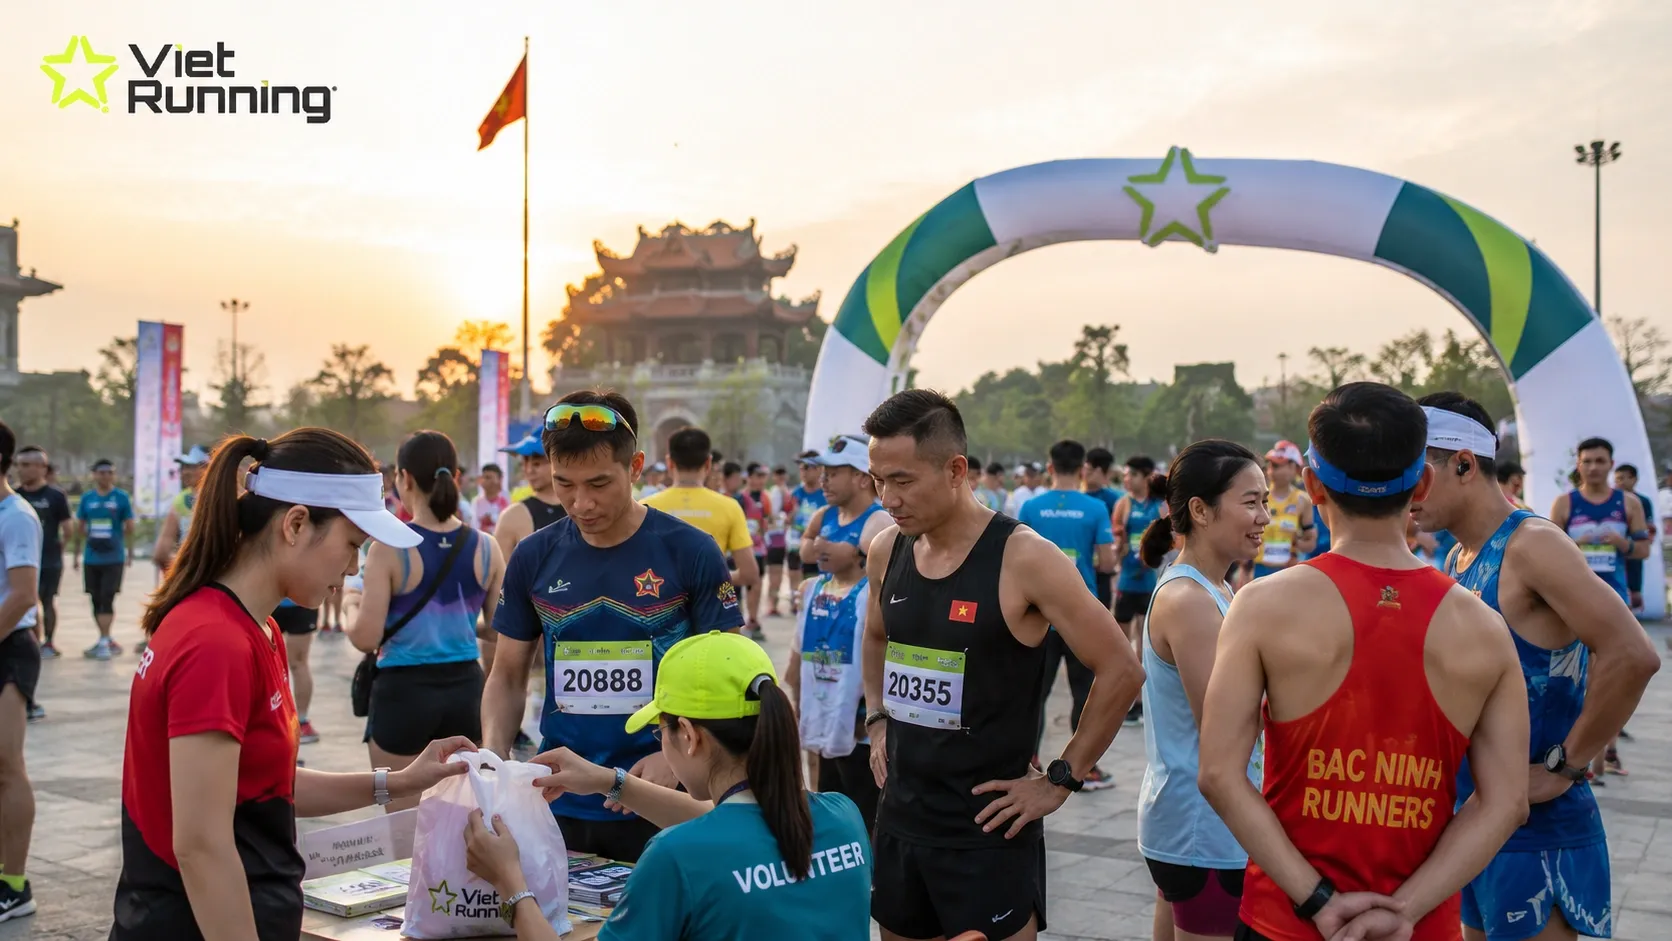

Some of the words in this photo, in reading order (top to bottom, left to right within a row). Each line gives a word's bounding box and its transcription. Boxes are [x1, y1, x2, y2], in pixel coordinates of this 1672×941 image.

[563, 668, 643, 693] 20888
[888, 671, 951, 706] 20355
[1307, 748, 1366, 783] BAC
[1374, 751, 1443, 790] NINH
[1302, 787, 1436, 830] RUNNERS
[461, 888, 500, 906] Viet
